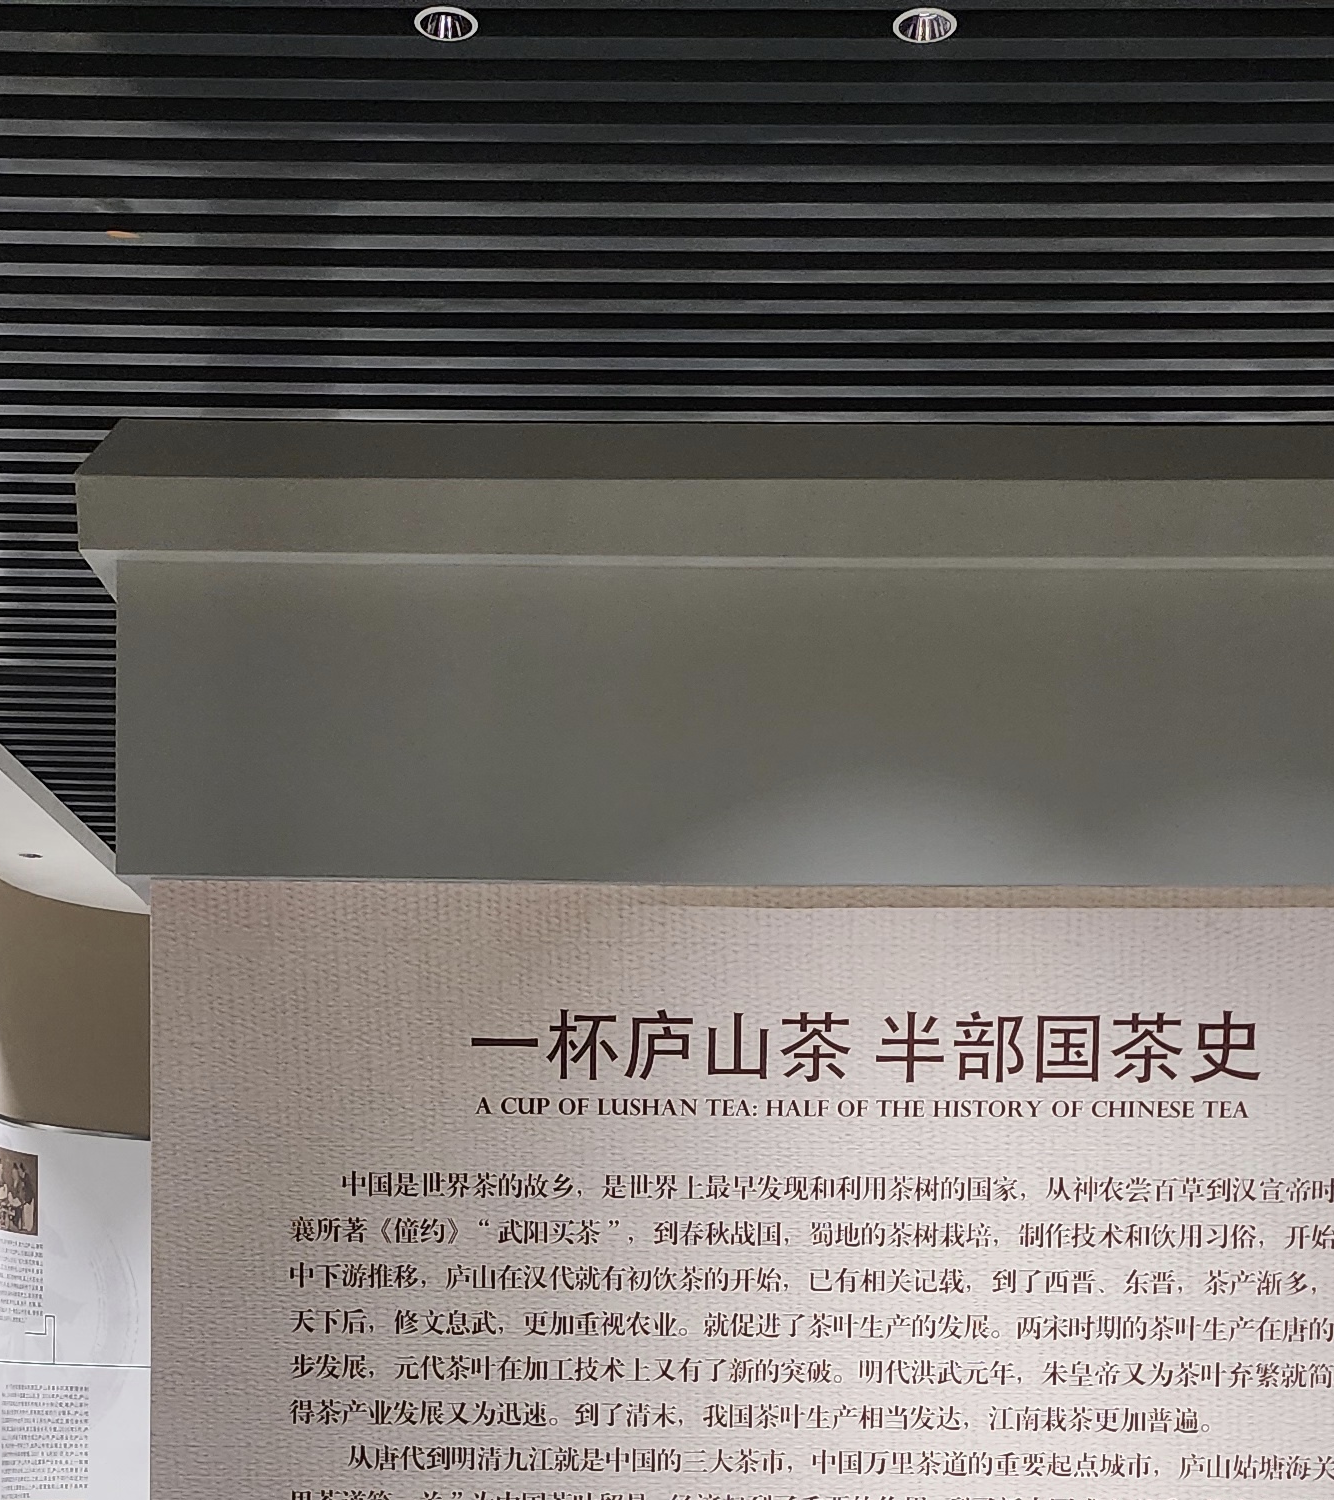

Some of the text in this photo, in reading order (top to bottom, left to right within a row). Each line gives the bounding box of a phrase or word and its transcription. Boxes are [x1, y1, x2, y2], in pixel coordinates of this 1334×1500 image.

[471, 1009, 1261, 1083] 一杯庐山茶 半部国茶史
[474, 1096, 1250, 1119] A CUP OF LUSHAN TEA: HALF OF THE HISTORY OF CHINESE TEA
